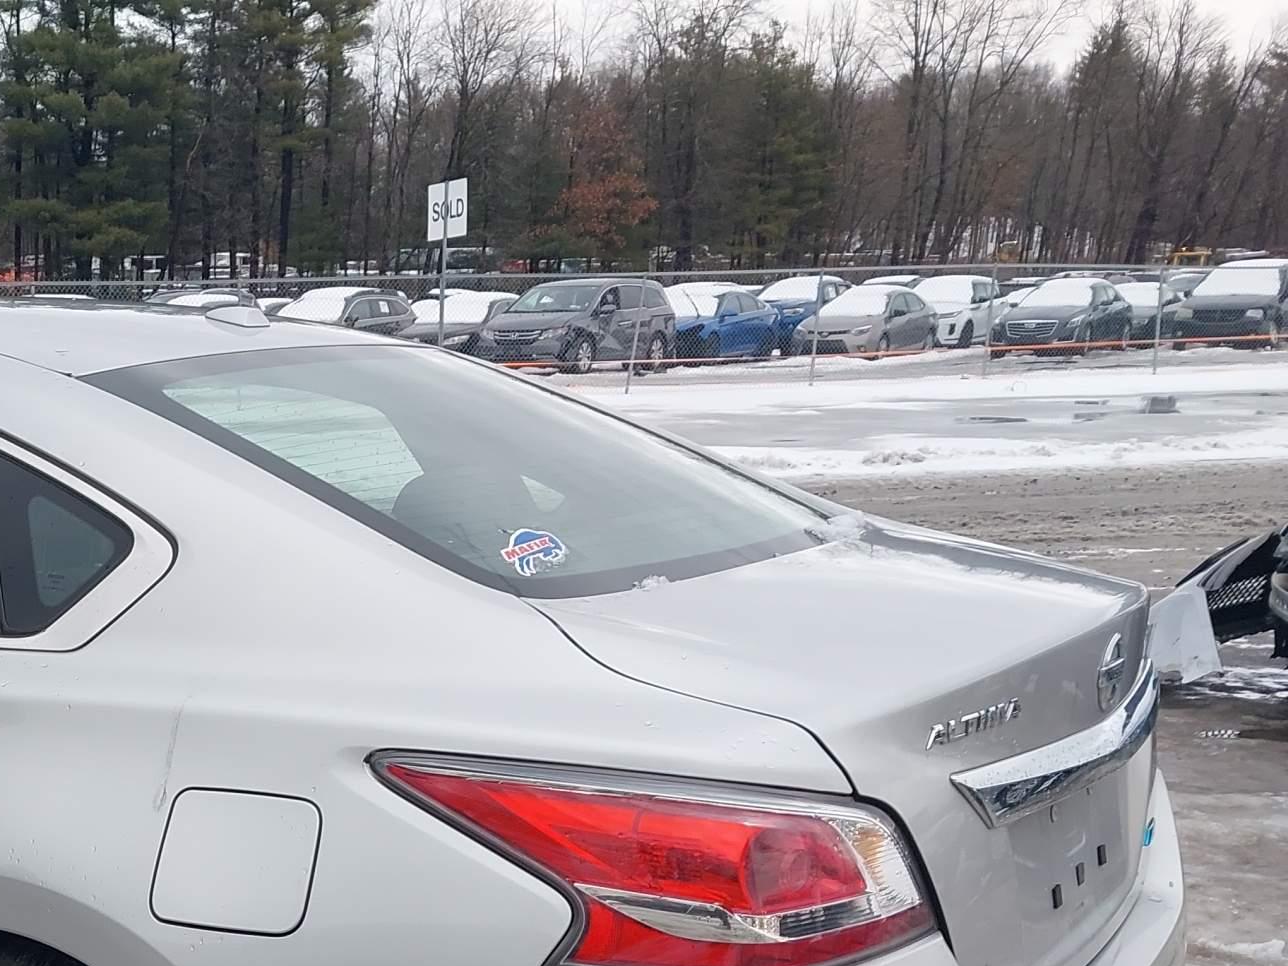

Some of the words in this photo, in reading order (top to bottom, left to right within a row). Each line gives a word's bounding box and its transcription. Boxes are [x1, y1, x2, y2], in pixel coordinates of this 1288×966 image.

[432, 198, 464, 222] SOLD
[505, 538, 549, 560] MAFIA
[925, 697, 1020, 751] ALTIMA
